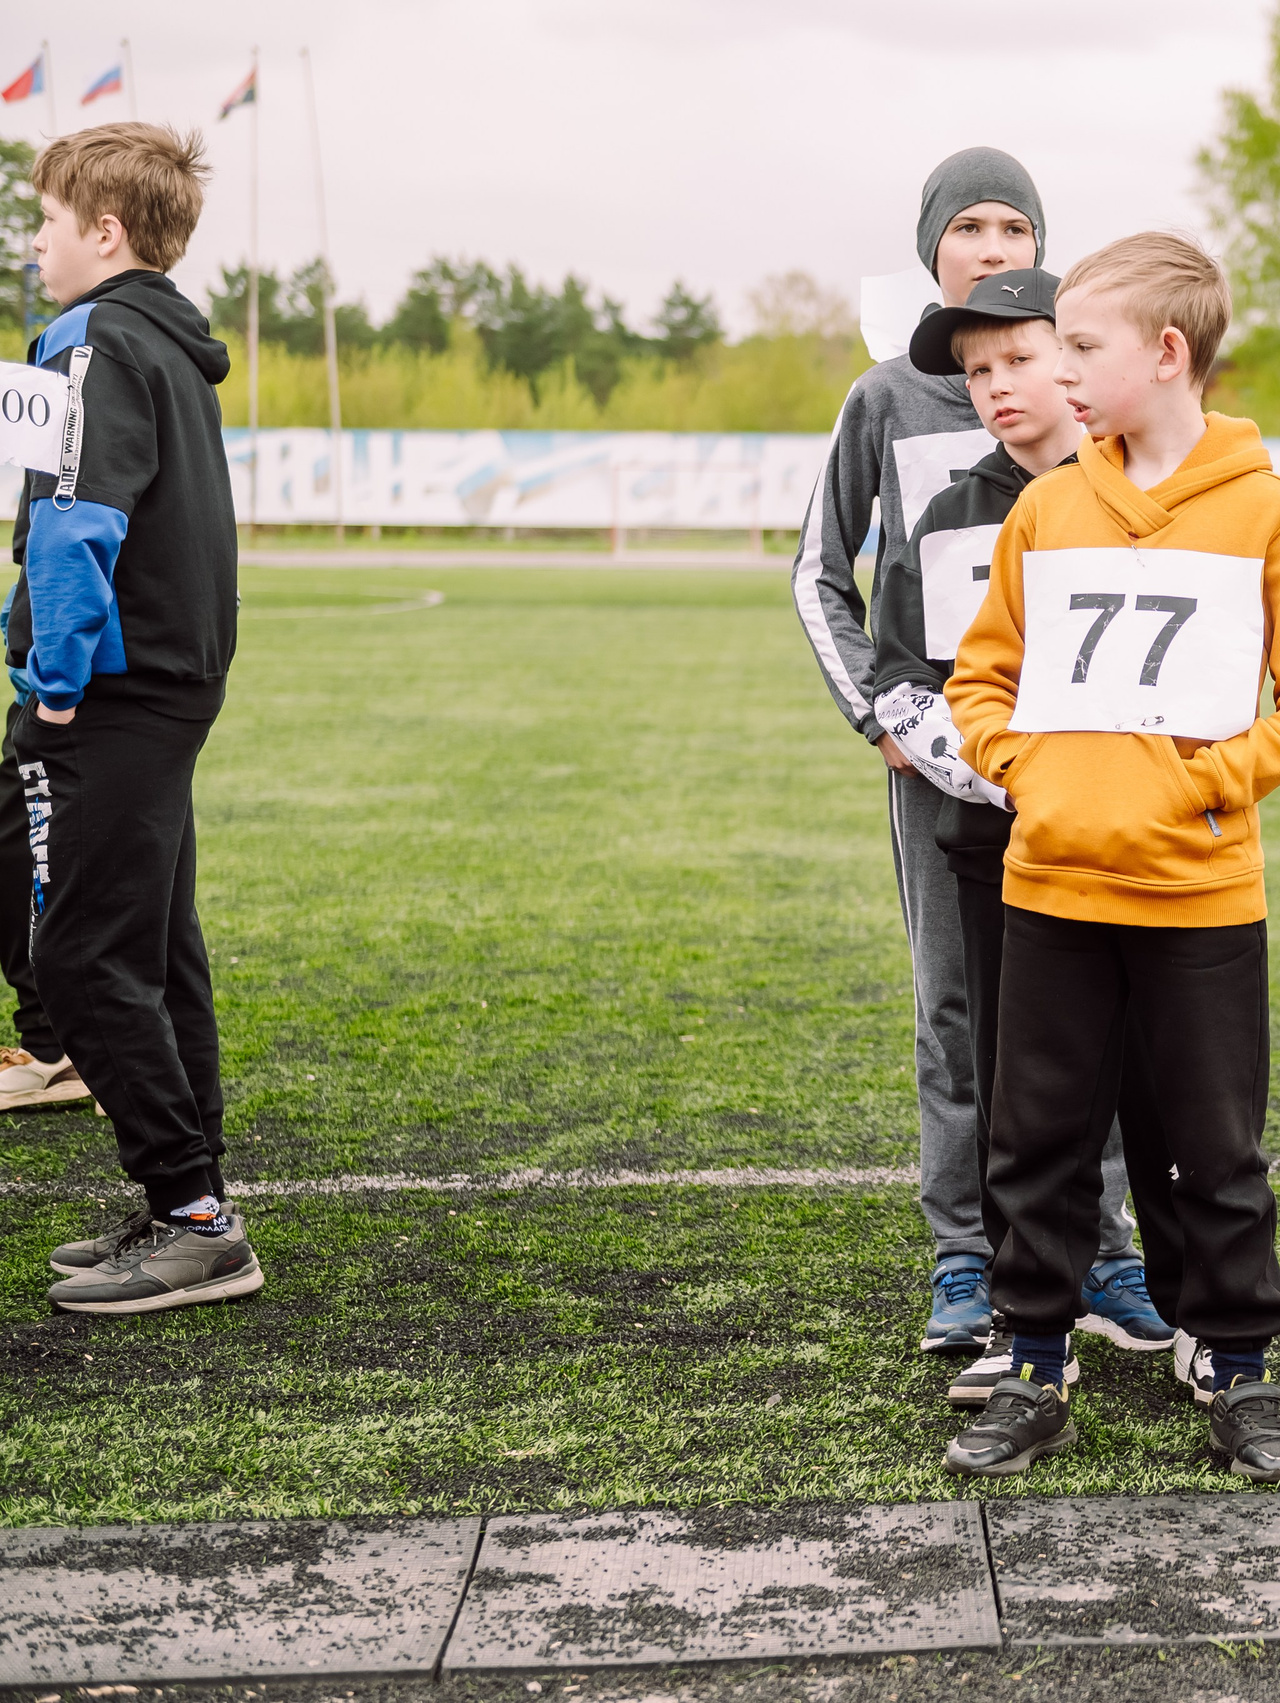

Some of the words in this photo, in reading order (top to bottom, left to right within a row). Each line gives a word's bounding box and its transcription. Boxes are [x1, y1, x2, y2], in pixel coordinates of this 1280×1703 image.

[2, 388, 51, 427] 00
[65, 408, 77, 454] WARNING
[1069, 593, 1198, 687] 77
